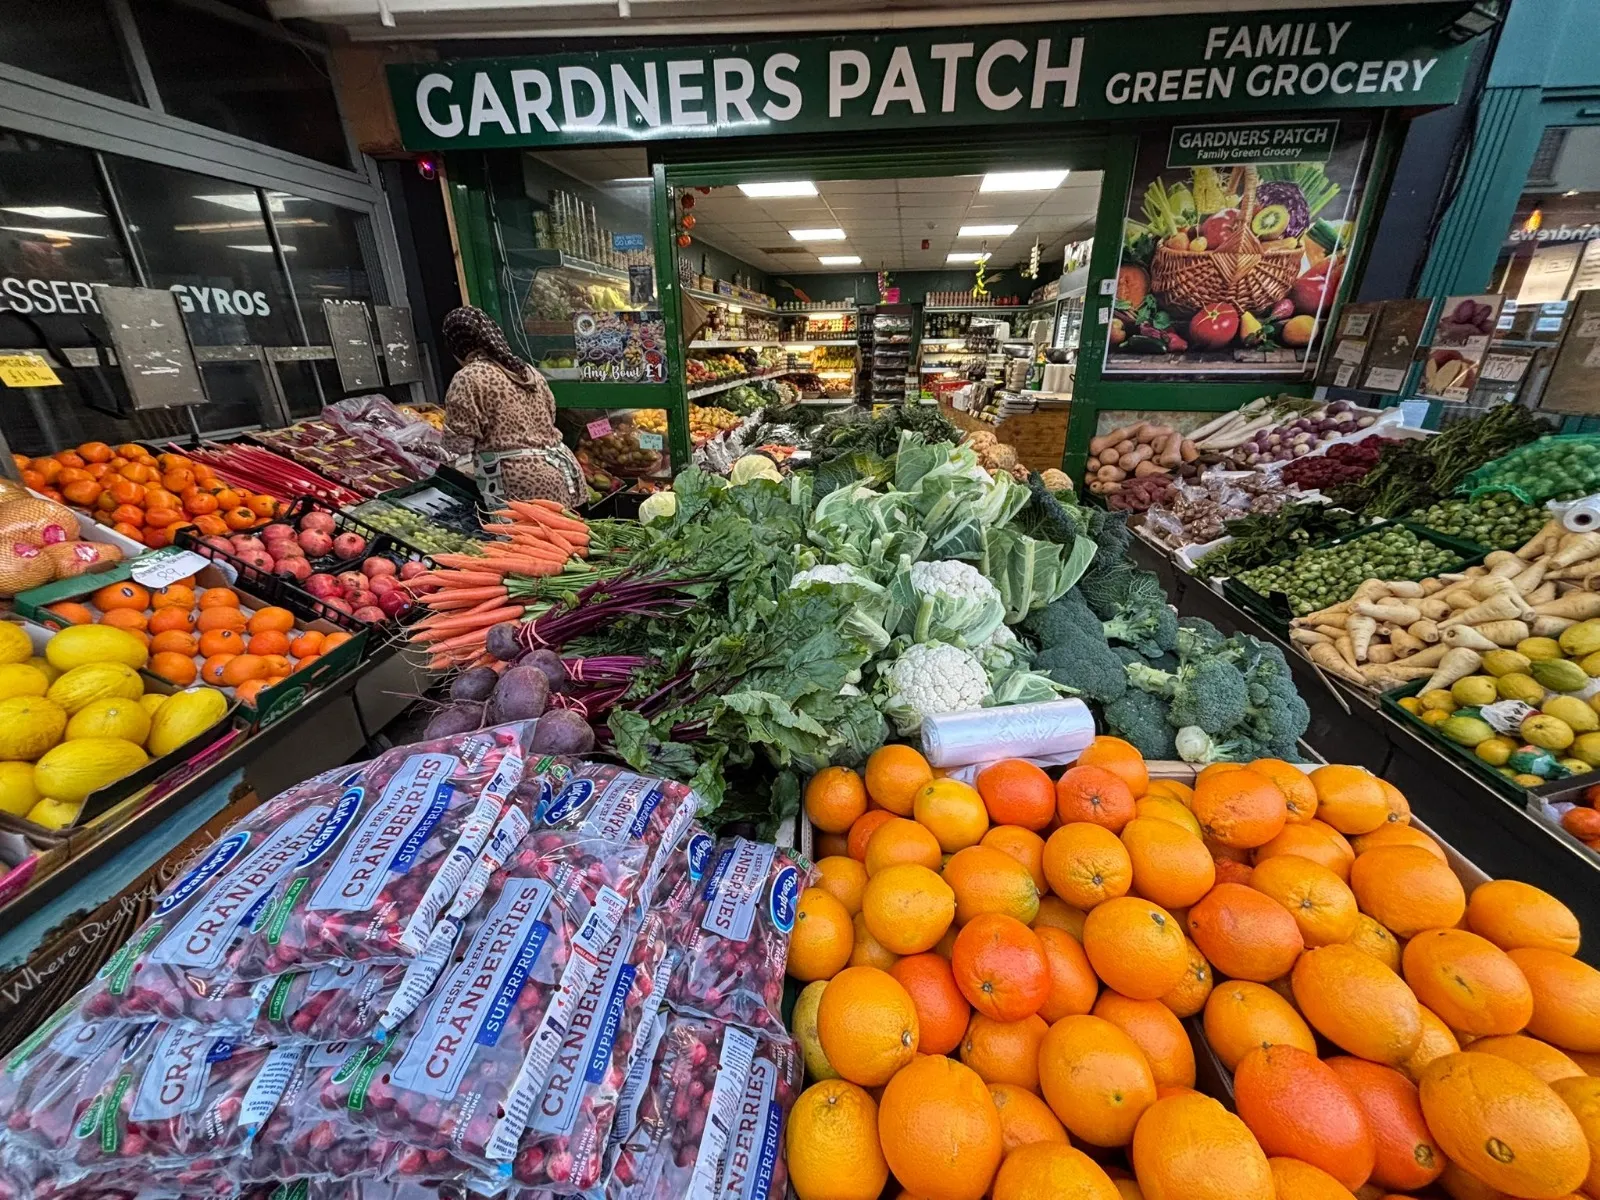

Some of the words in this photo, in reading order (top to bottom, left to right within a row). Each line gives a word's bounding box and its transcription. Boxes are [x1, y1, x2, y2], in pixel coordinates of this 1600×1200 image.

[1106, 66, 1233, 105] GREEN
[1246, 58, 1438, 97] GROCERY
[1204, 21, 1353, 61] FAMILY
[416, 53, 803, 138] GARDNERS
[829, 37, 1085, 118] PATCH
[1179, 129, 1270, 148] GARDNERS
[1273, 128, 1329, 145] PATCH
[1197, 149, 1230, 160] Family
[1231, 148, 1260, 158] Green
[1262, 147, 1302, 158] Grocery
[169, 284, 271, 317] GYROS
[583, 366, 607, 381] Any
[611, 365, 641, 380] Bowl
[645, 363, 662, 378] £1
[342, 758, 441, 898] CRANBERRIES
[350, 829, 374, 864] FRESH
[370, 785, 408, 829] PREMIUM
[399, 792, 449, 863] SUPERFRUIT
[163, 871, 210, 909] Ocean
[201, 841, 240, 871] Spray
[716, 840, 758, 930] RANBERRIES
[2, 944, 80, 1004] Where
[80, 880, 160, 944] Quality
[425, 887, 539, 1079] CRANBERRIES
[436, 979, 466, 1025] FRESH
[461, 917, 503, 977] PREMIUM
[486, 930, 543, 1032] SUPERFRUIT
[541, 934, 622, 1117] CRANBERRIES
[593, 971, 633, 1071] SUPERFRUIT
[727, 1062, 766, 1198] NBERRIES
[756, 1111, 780, 1200] UPERFRUIT
